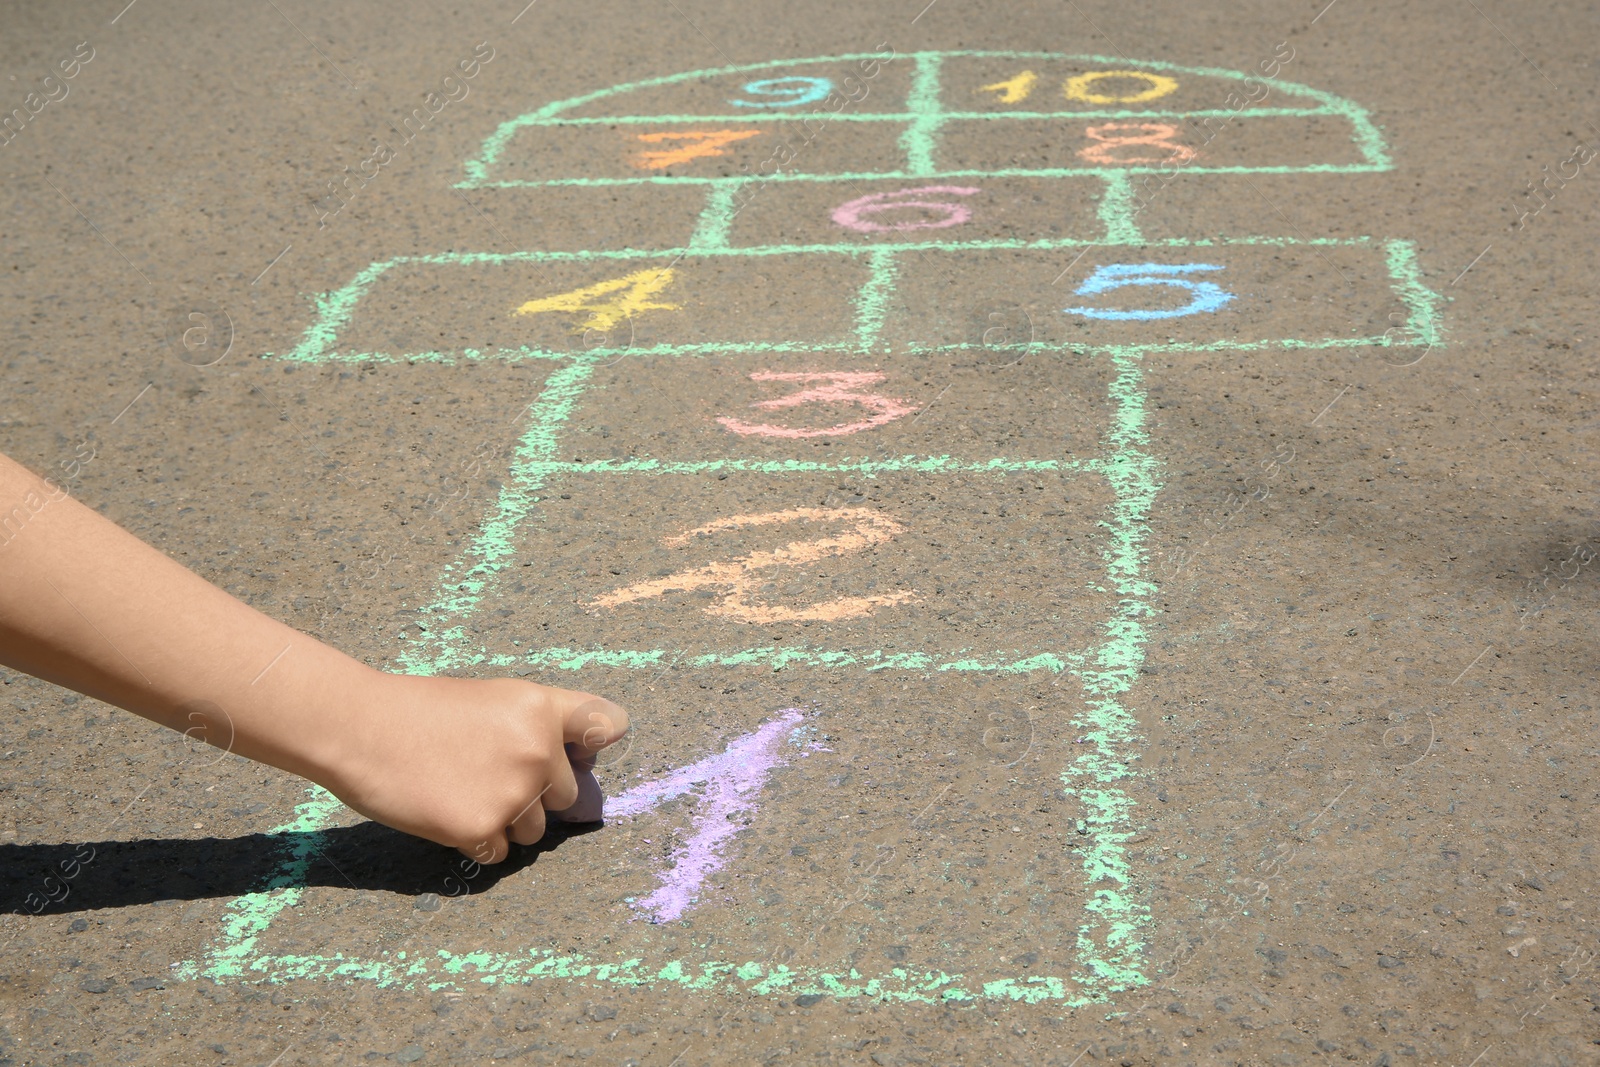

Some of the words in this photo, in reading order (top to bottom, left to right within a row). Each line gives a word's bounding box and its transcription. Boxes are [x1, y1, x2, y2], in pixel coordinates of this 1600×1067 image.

[727, 76, 835, 108] 9
[977, 69, 1180, 104] 10
[630, 128, 763, 170] 7
[1078, 122, 1198, 165] 8
[831, 185, 981, 233] 6
[513, 266, 681, 334] 4
[1064, 262, 1236, 321] 5
[716, 369, 921, 439] 3
[586, 506, 922, 624] 2
[602, 707, 806, 924] 1
